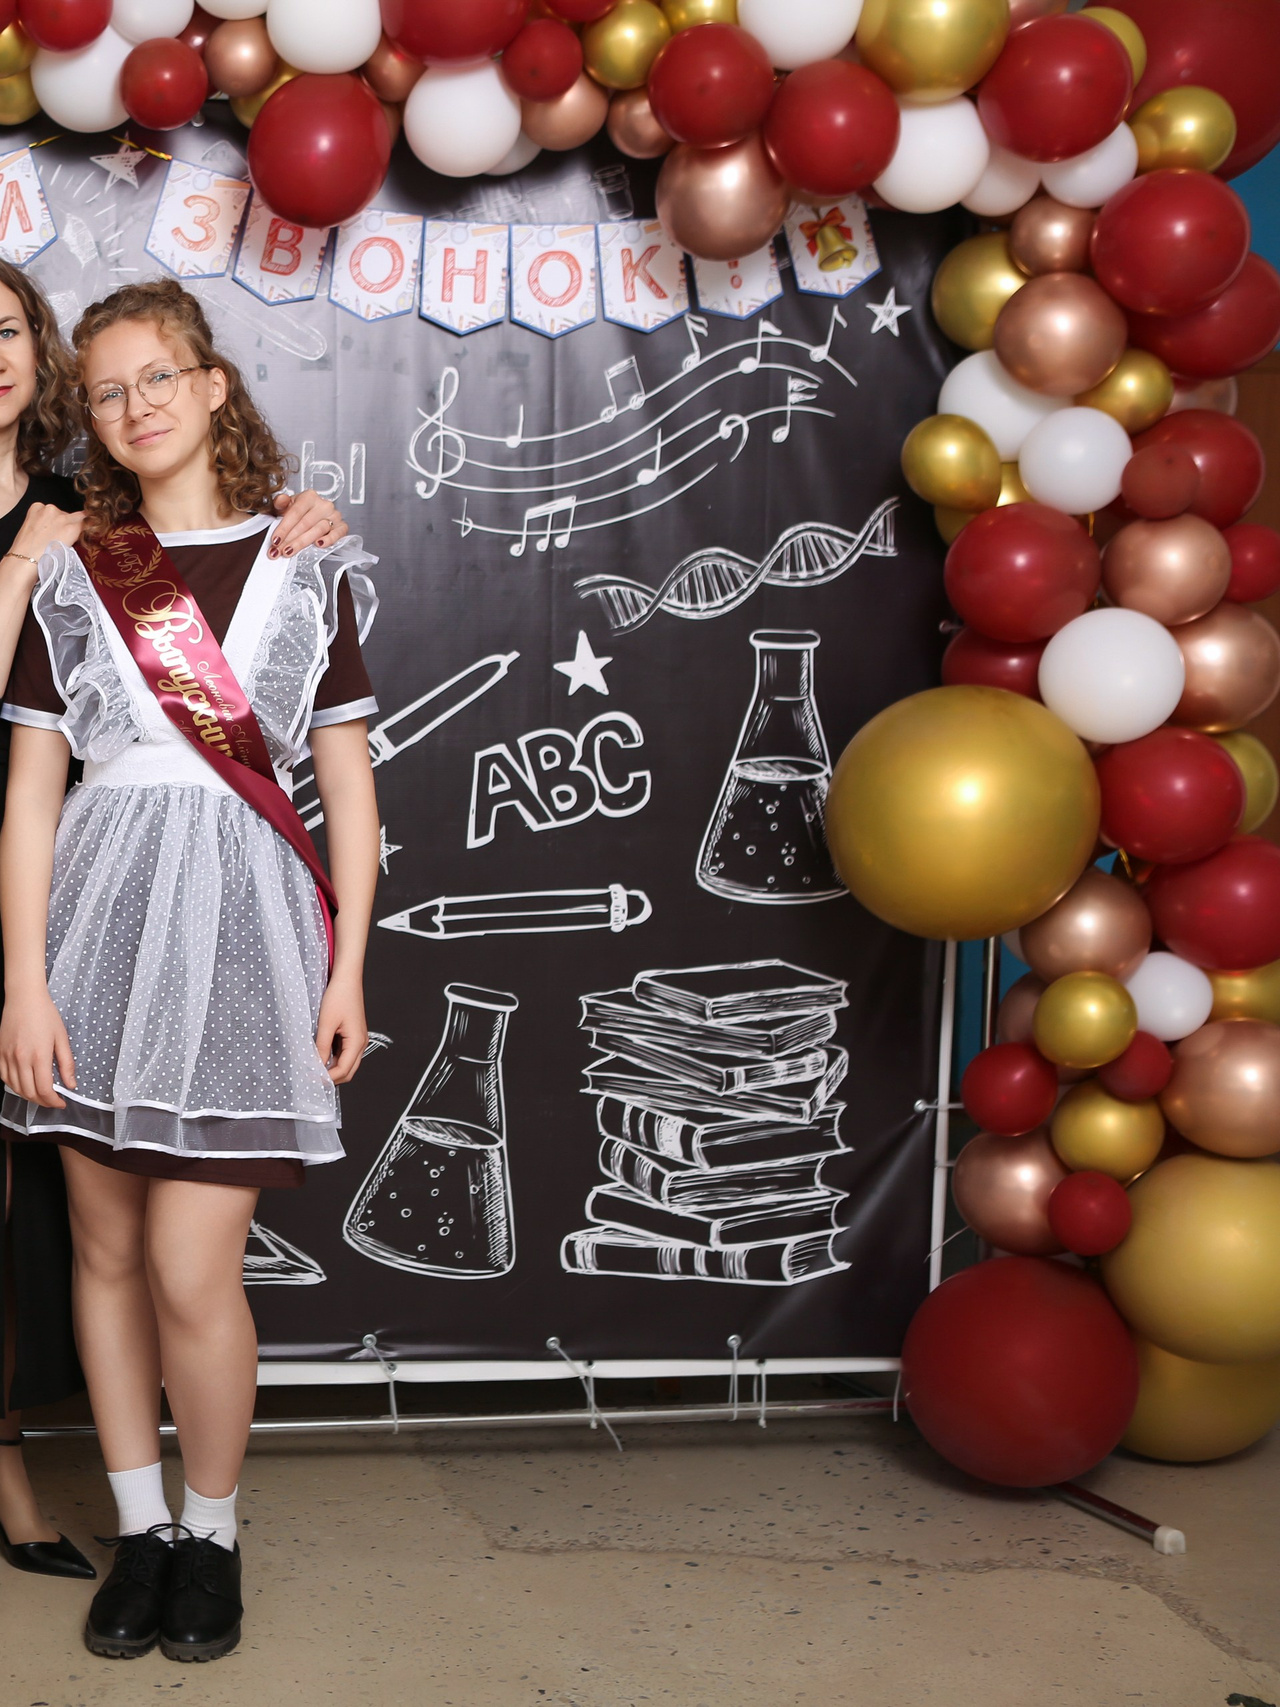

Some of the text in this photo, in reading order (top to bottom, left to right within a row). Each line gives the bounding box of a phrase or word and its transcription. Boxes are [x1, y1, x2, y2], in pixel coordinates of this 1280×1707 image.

[122, 579, 234, 758] Выпускни
[197, 661, 235, 722] Леонович
[467, 711, 651, 849] ABC
